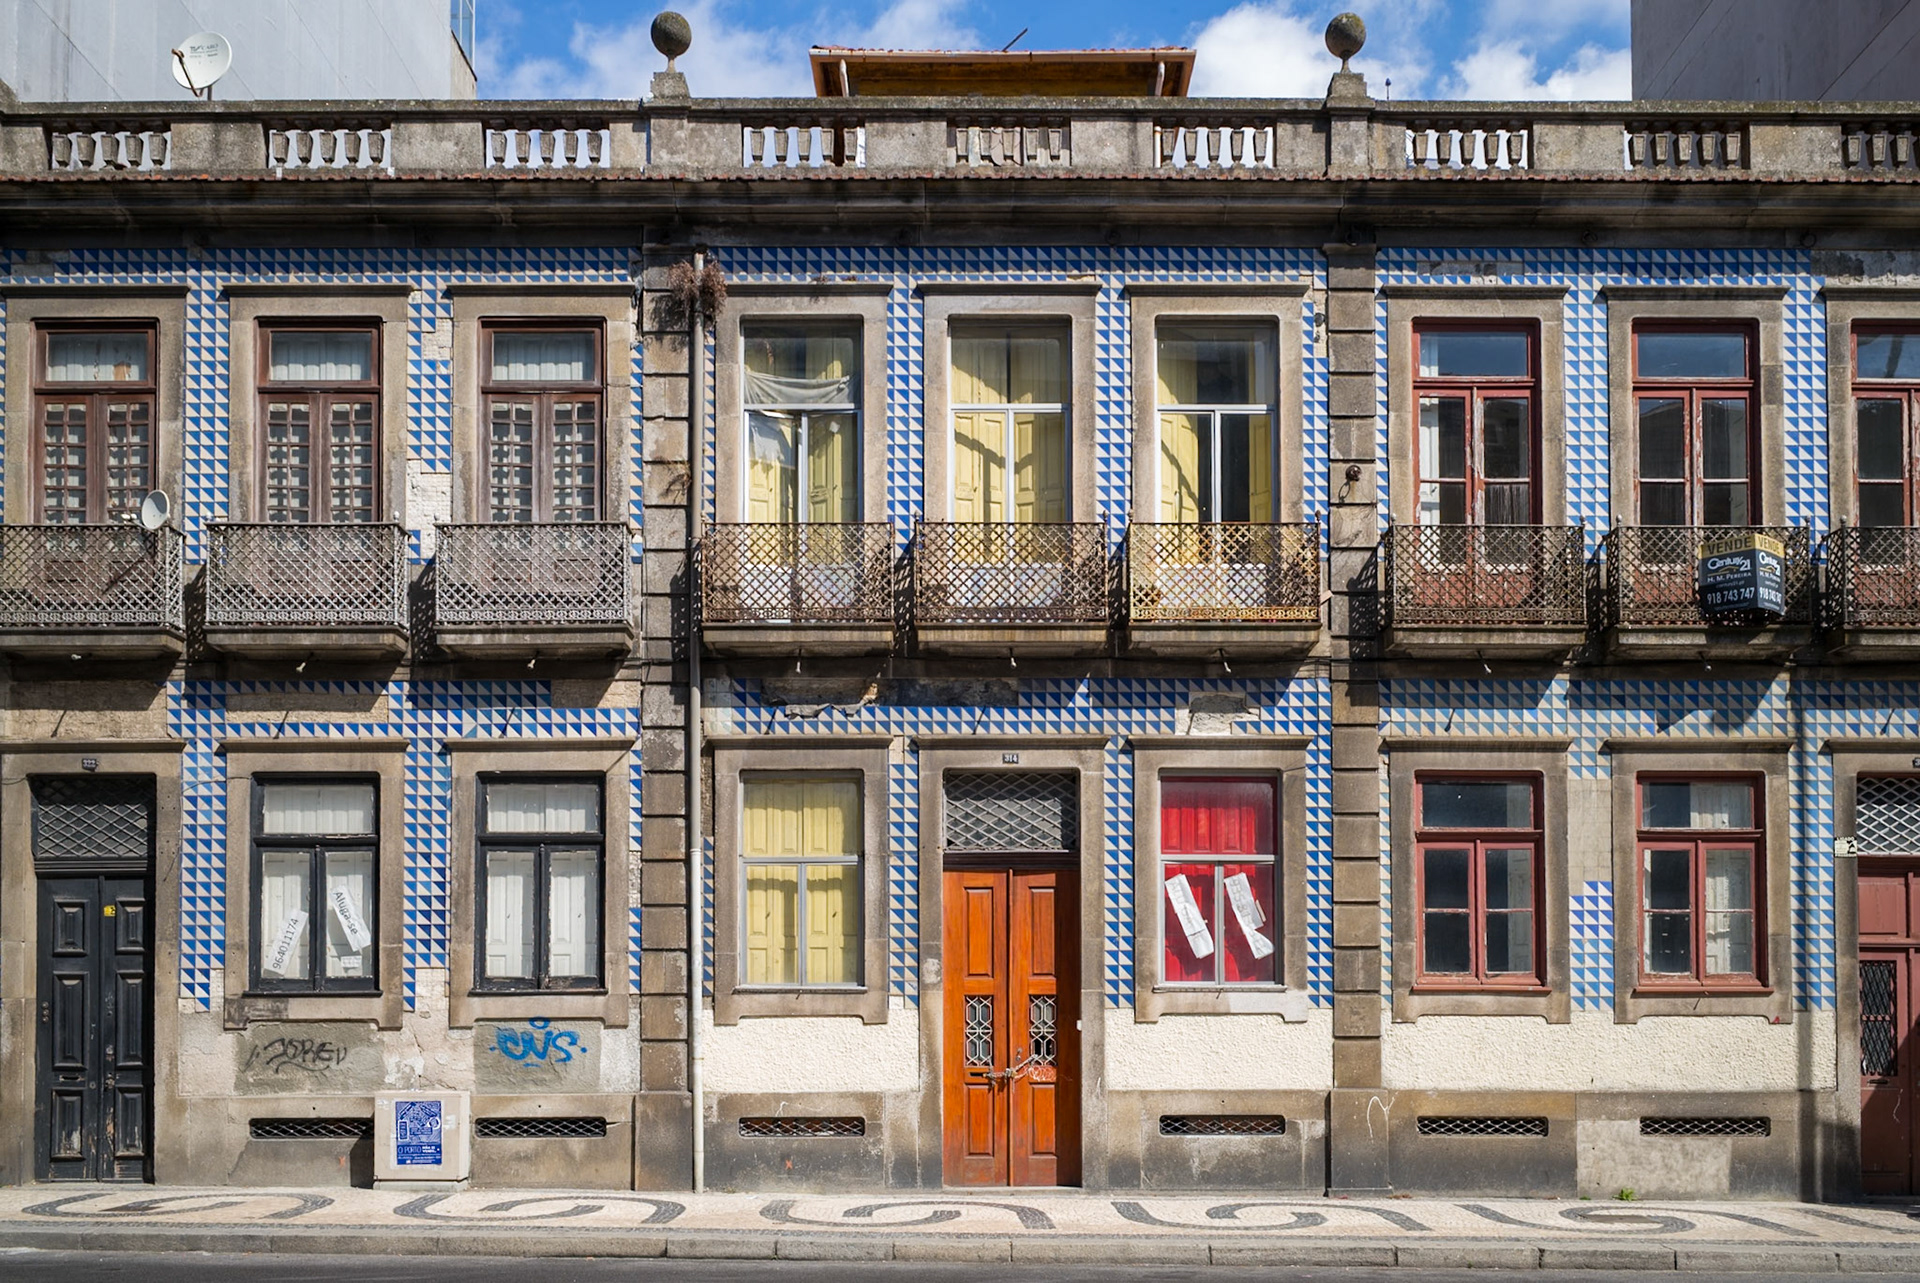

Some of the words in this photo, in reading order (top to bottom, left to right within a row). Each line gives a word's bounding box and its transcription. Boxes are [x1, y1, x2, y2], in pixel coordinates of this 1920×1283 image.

[1708, 537, 1751, 555] VENDE
[1757, 536, 1780, 554] VENDE
[1707, 556, 1743, 570] Century
[1740, 559, 1751, 571] 21
[1707, 591, 1722, 604] 918
[1723, 589, 1738, 602] 743
[1740, 587, 1755, 600] 747
[1004, 754, 1018, 763] 314
[334, 891, 359, 936] Aluga-se
[272, 917, 299, 969] 964011174
